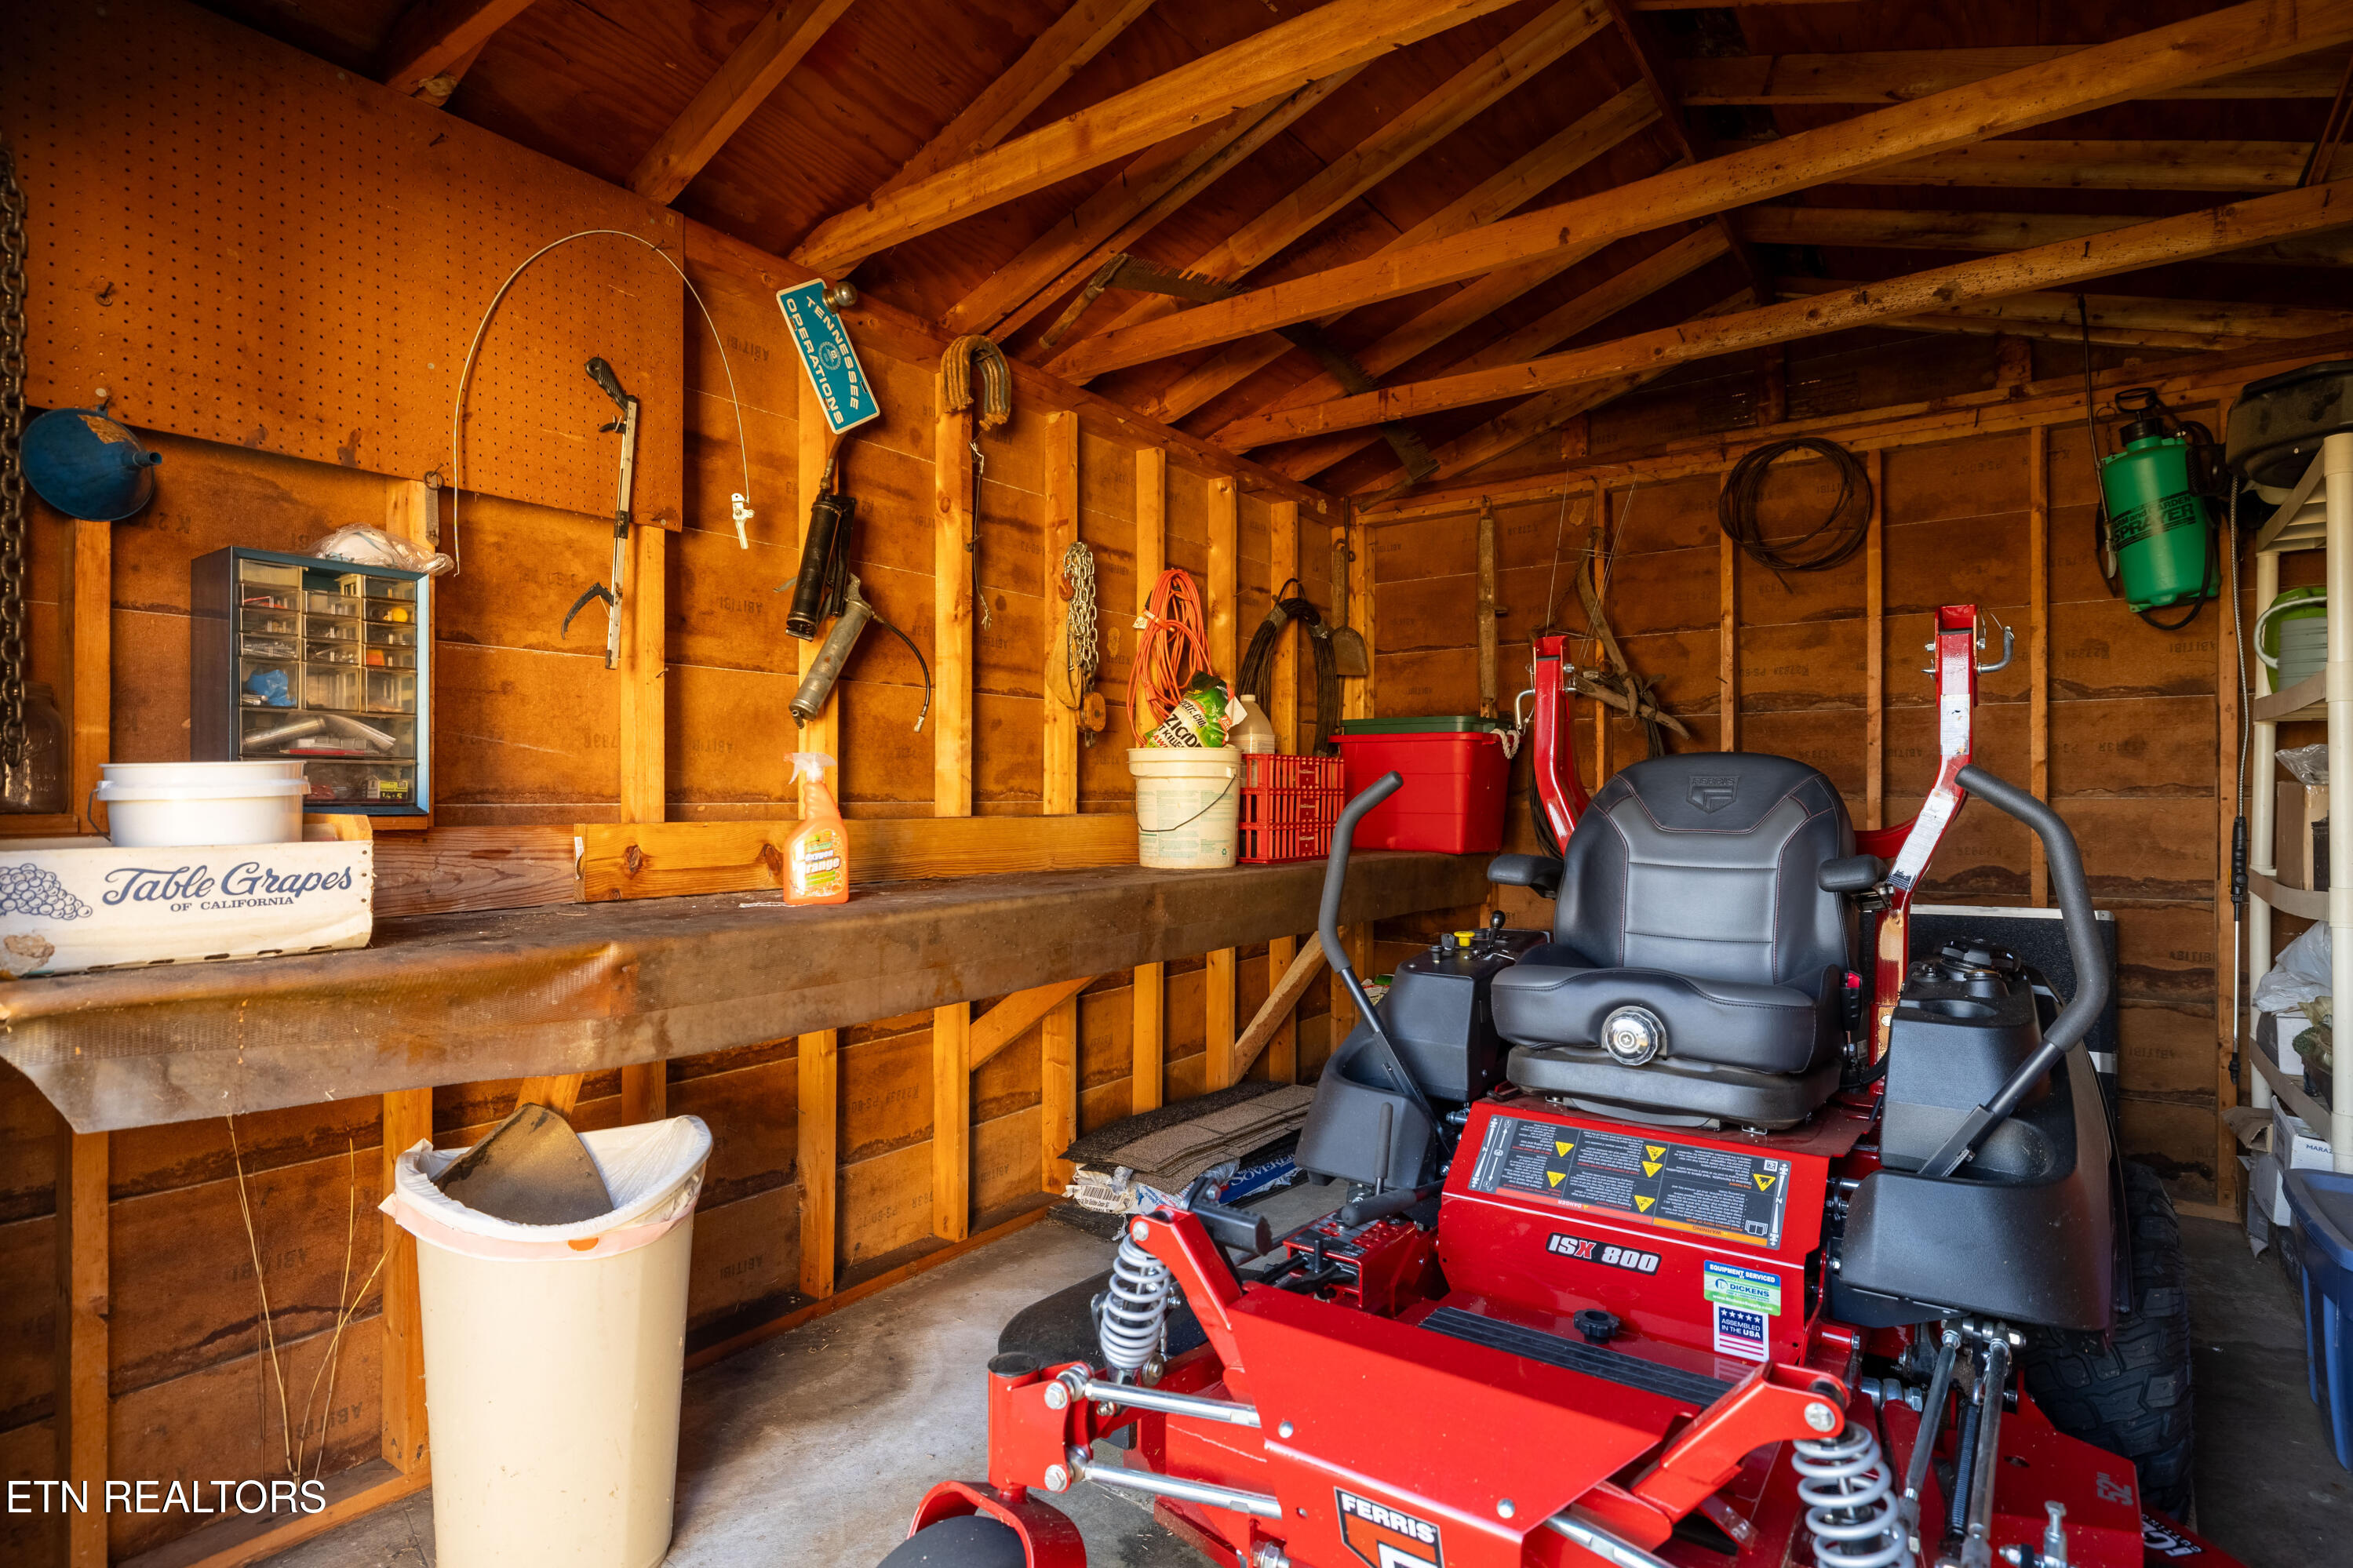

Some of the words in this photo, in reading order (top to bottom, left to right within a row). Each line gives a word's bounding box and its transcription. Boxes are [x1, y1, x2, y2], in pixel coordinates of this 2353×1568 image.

[726, 335, 770, 362] ABITIBI
[807, 295, 859, 410] TENNESSEE
[786, 298, 844, 424] OPERATIONS
[2151, 495, 2191, 512] ARDEN
[2114, 503, 2195, 541] SPRAYER
[583, 733, 618, 751] 783R
[1886, 747, 1923, 759] ABITIB
[804, 856, 841, 874] range
[102, 864, 215, 905] Table
[221, 861, 352, 897] Grapes
[169, 903, 193, 911] OF
[200, 897, 295, 911] CALIFORNIA
[2305, 1143, 2333, 1155] MARAZ
[912, 1191, 934, 1208] 783R
[1557, 1199, 1582, 1208] DANGER
[1692, 1224, 1721, 1235] WARNING
[1548, 1234, 1597, 1259] ISX
[1601, 1246, 1659, 1272] 800
[719, 1254, 763, 1280] ABITIBI
[1710, 1264, 1744, 1276] EQUIPMENT
[1745, 1271, 1775, 1282] SERVICED
[1730, 1283, 1769, 1297] DICKENS
[1721, 1319, 1761, 1331] ASSEMBLED
[1743, 1329, 1761, 1338] USA
[1341, 1493, 1436, 1544] FERRIS
